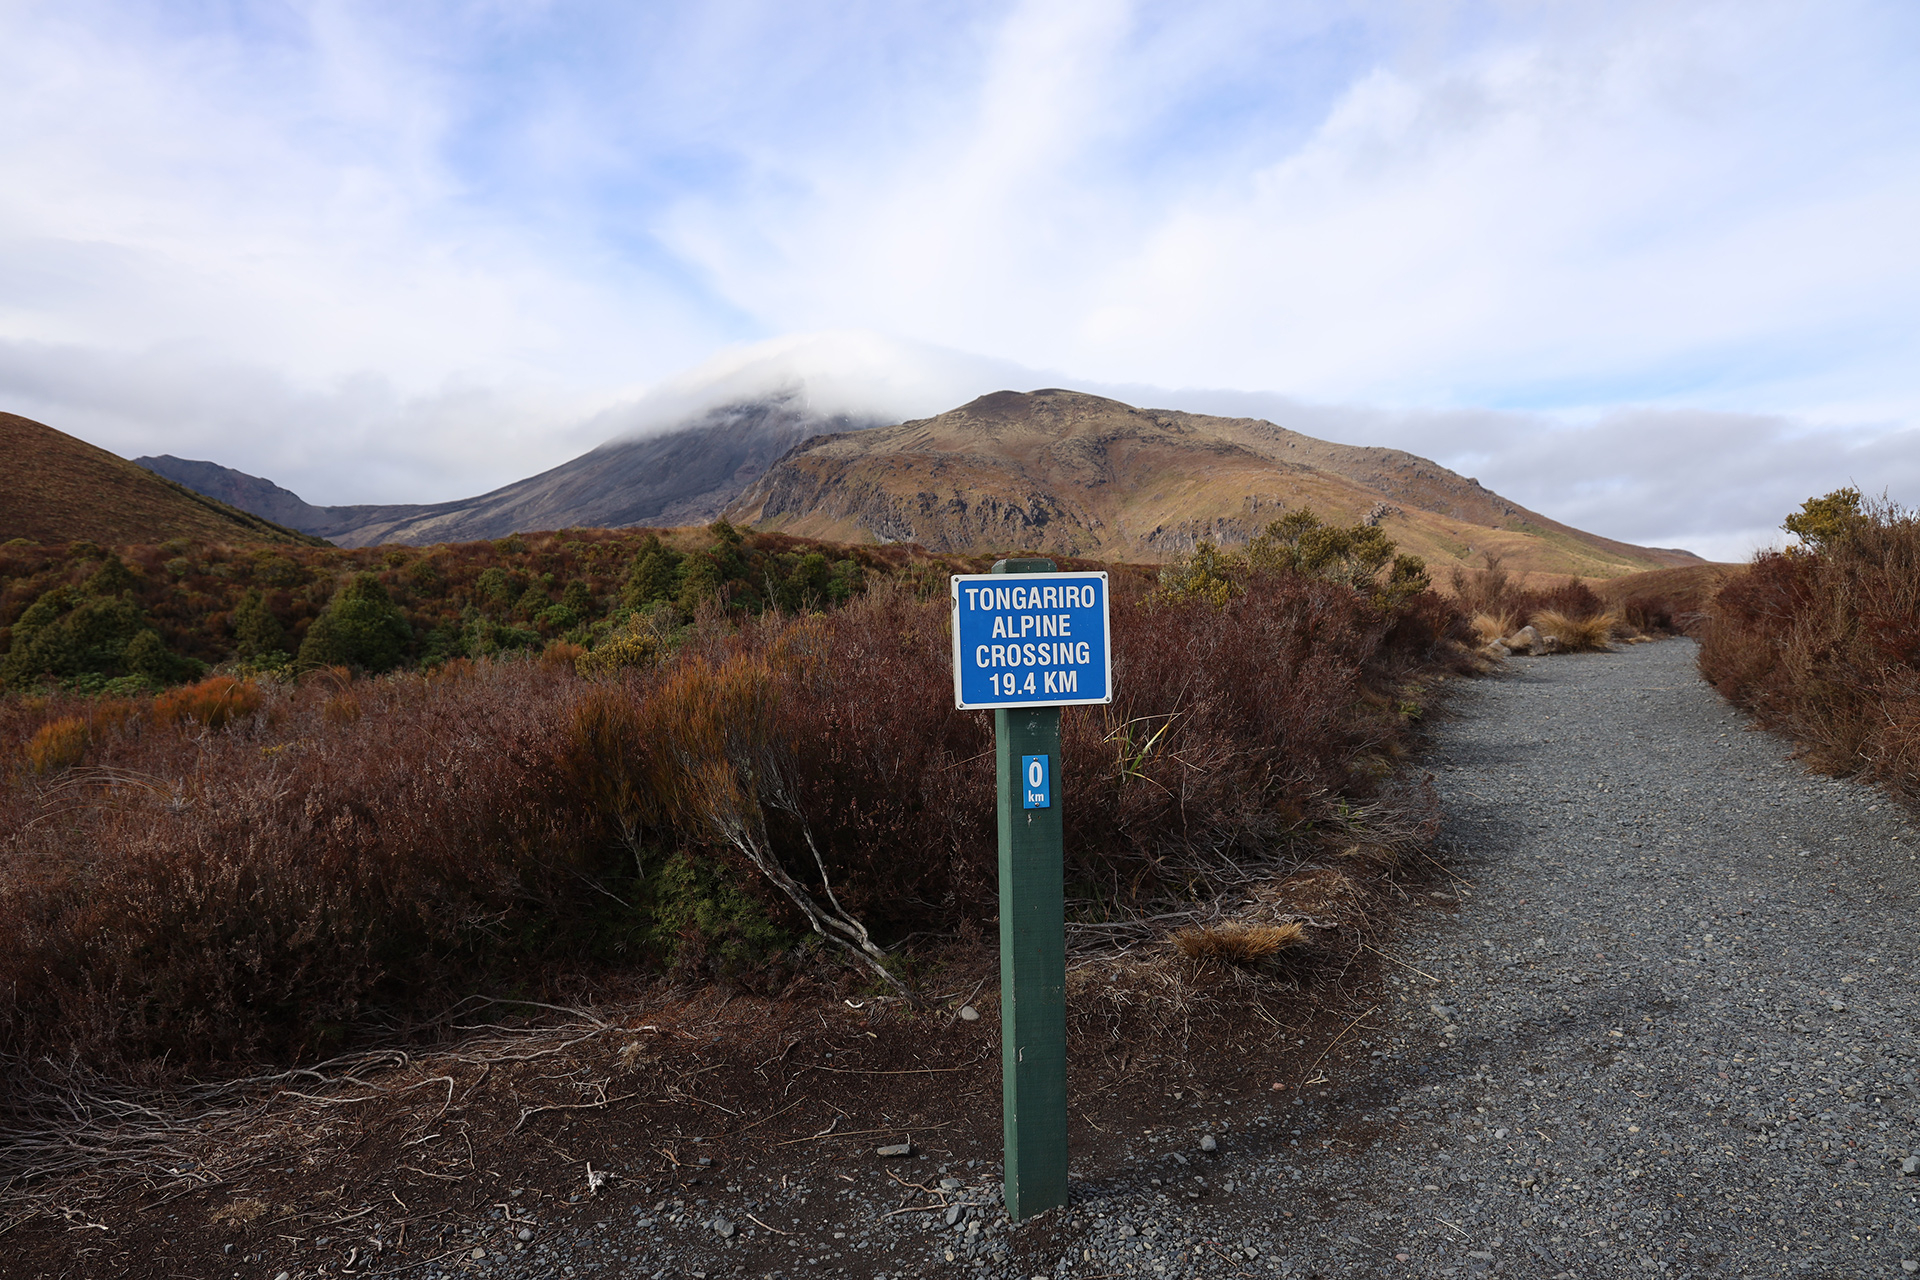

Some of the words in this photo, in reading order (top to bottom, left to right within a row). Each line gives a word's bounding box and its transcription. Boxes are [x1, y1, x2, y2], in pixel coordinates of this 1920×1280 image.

[964, 585, 1096, 611] TONGARIRO
[991, 614, 1072, 639] ALPINE
[976, 641, 1090, 668] CROSSING
[989, 672, 1037, 696] 19.4
[1044, 670, 1078, 695] KM
[1028, 761, 1043, 788] 0
[1028, 789, 1045, 802] km
